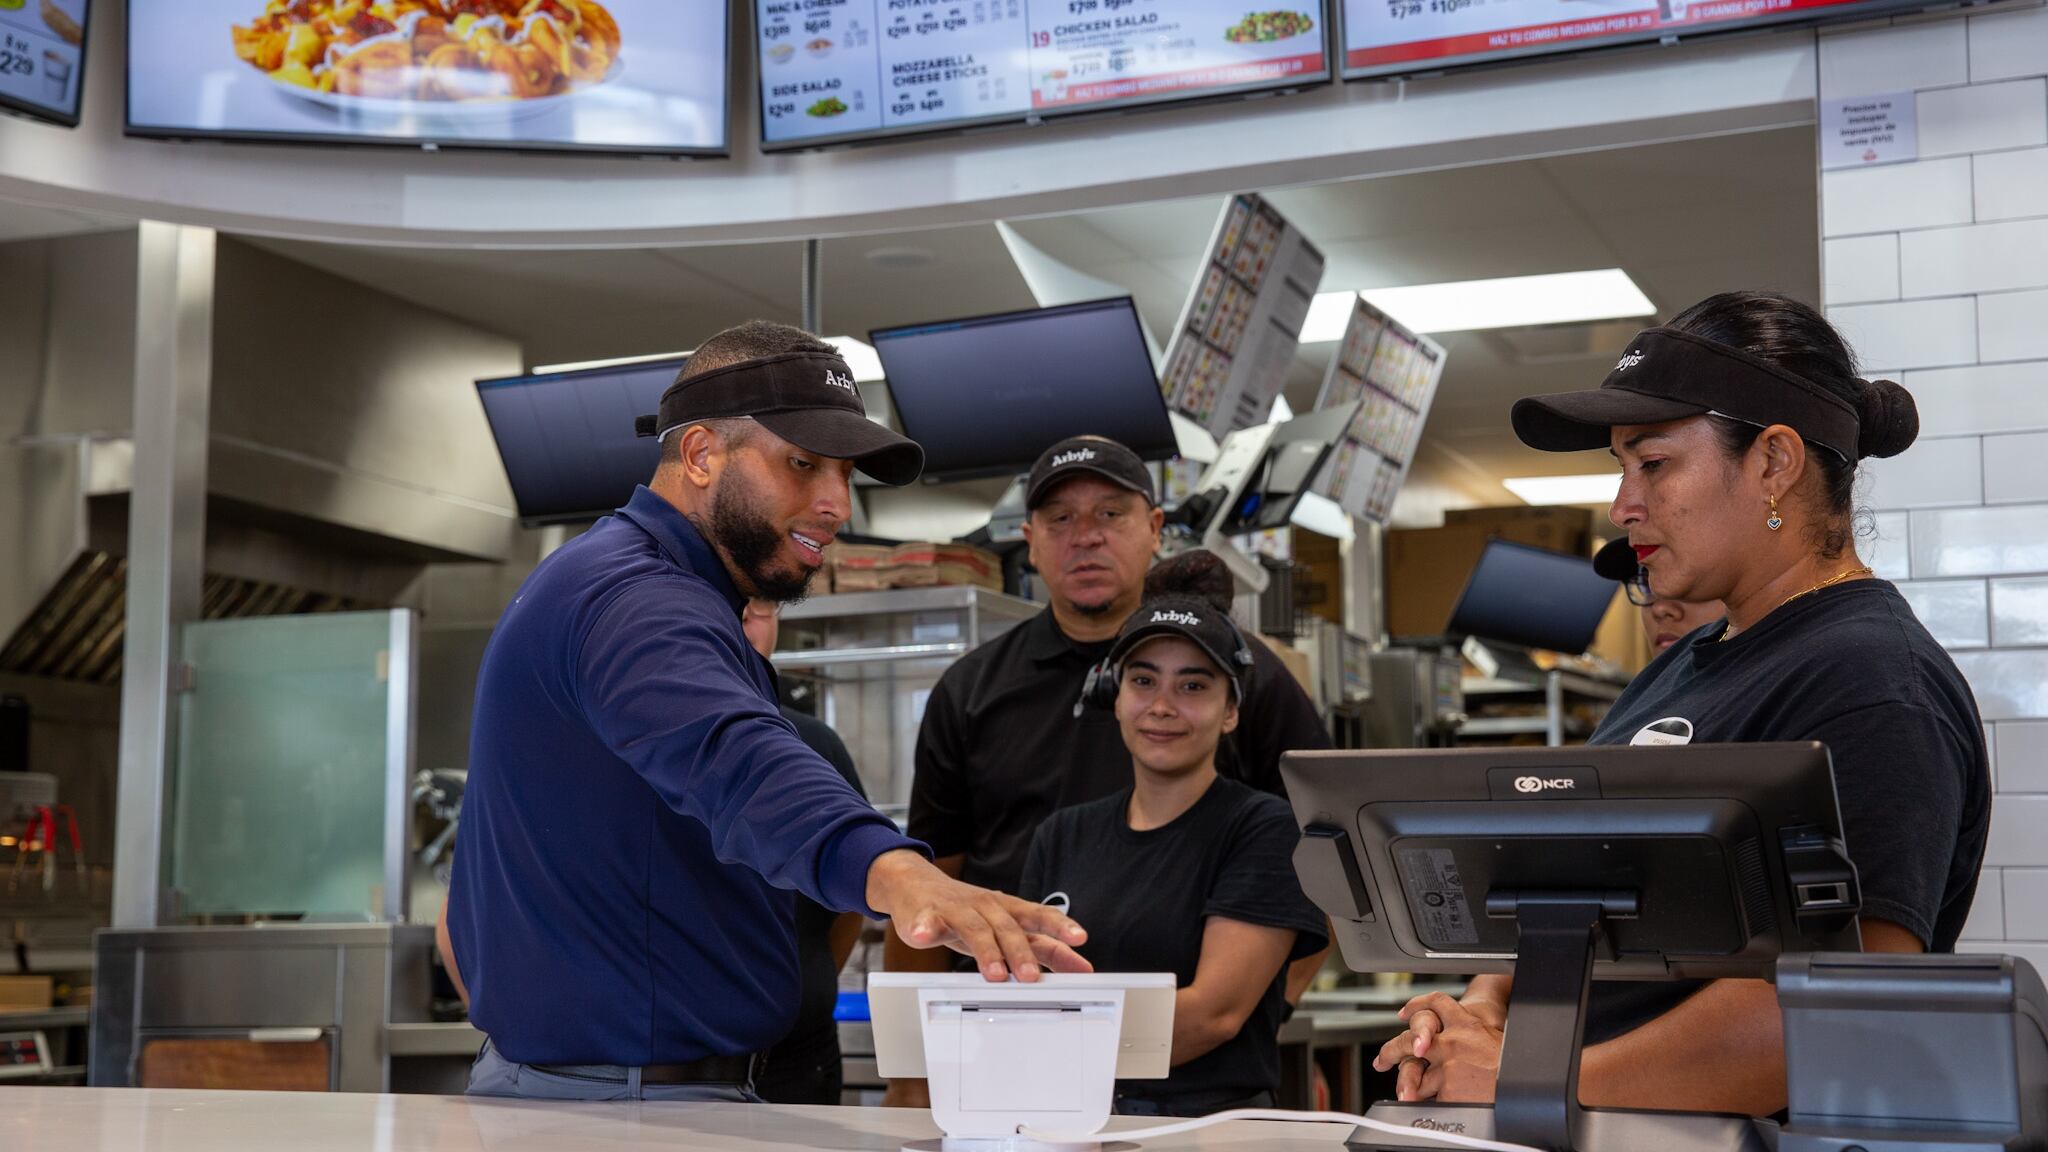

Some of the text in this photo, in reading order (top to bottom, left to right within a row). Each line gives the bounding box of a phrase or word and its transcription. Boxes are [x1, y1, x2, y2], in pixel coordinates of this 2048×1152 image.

[1054, 20, 1111, 37] CHICKEN
[1115, 13, 1158, 29] SALAD
[1032, 31, 1051, 49] 19
[893, 54, 974, 74] MOZZARELLA
[893, 65, 988, 87] CHEESE STICKS
[772, 78, 842, 97] SIDE SALAD
[1051, 447, 1096, 467] Arby's
[1150, 609, 1200, 626] Arby's
[1543, 778, 1575, 789] NCR
[1435, 1119, 1465, 1134] NCR
